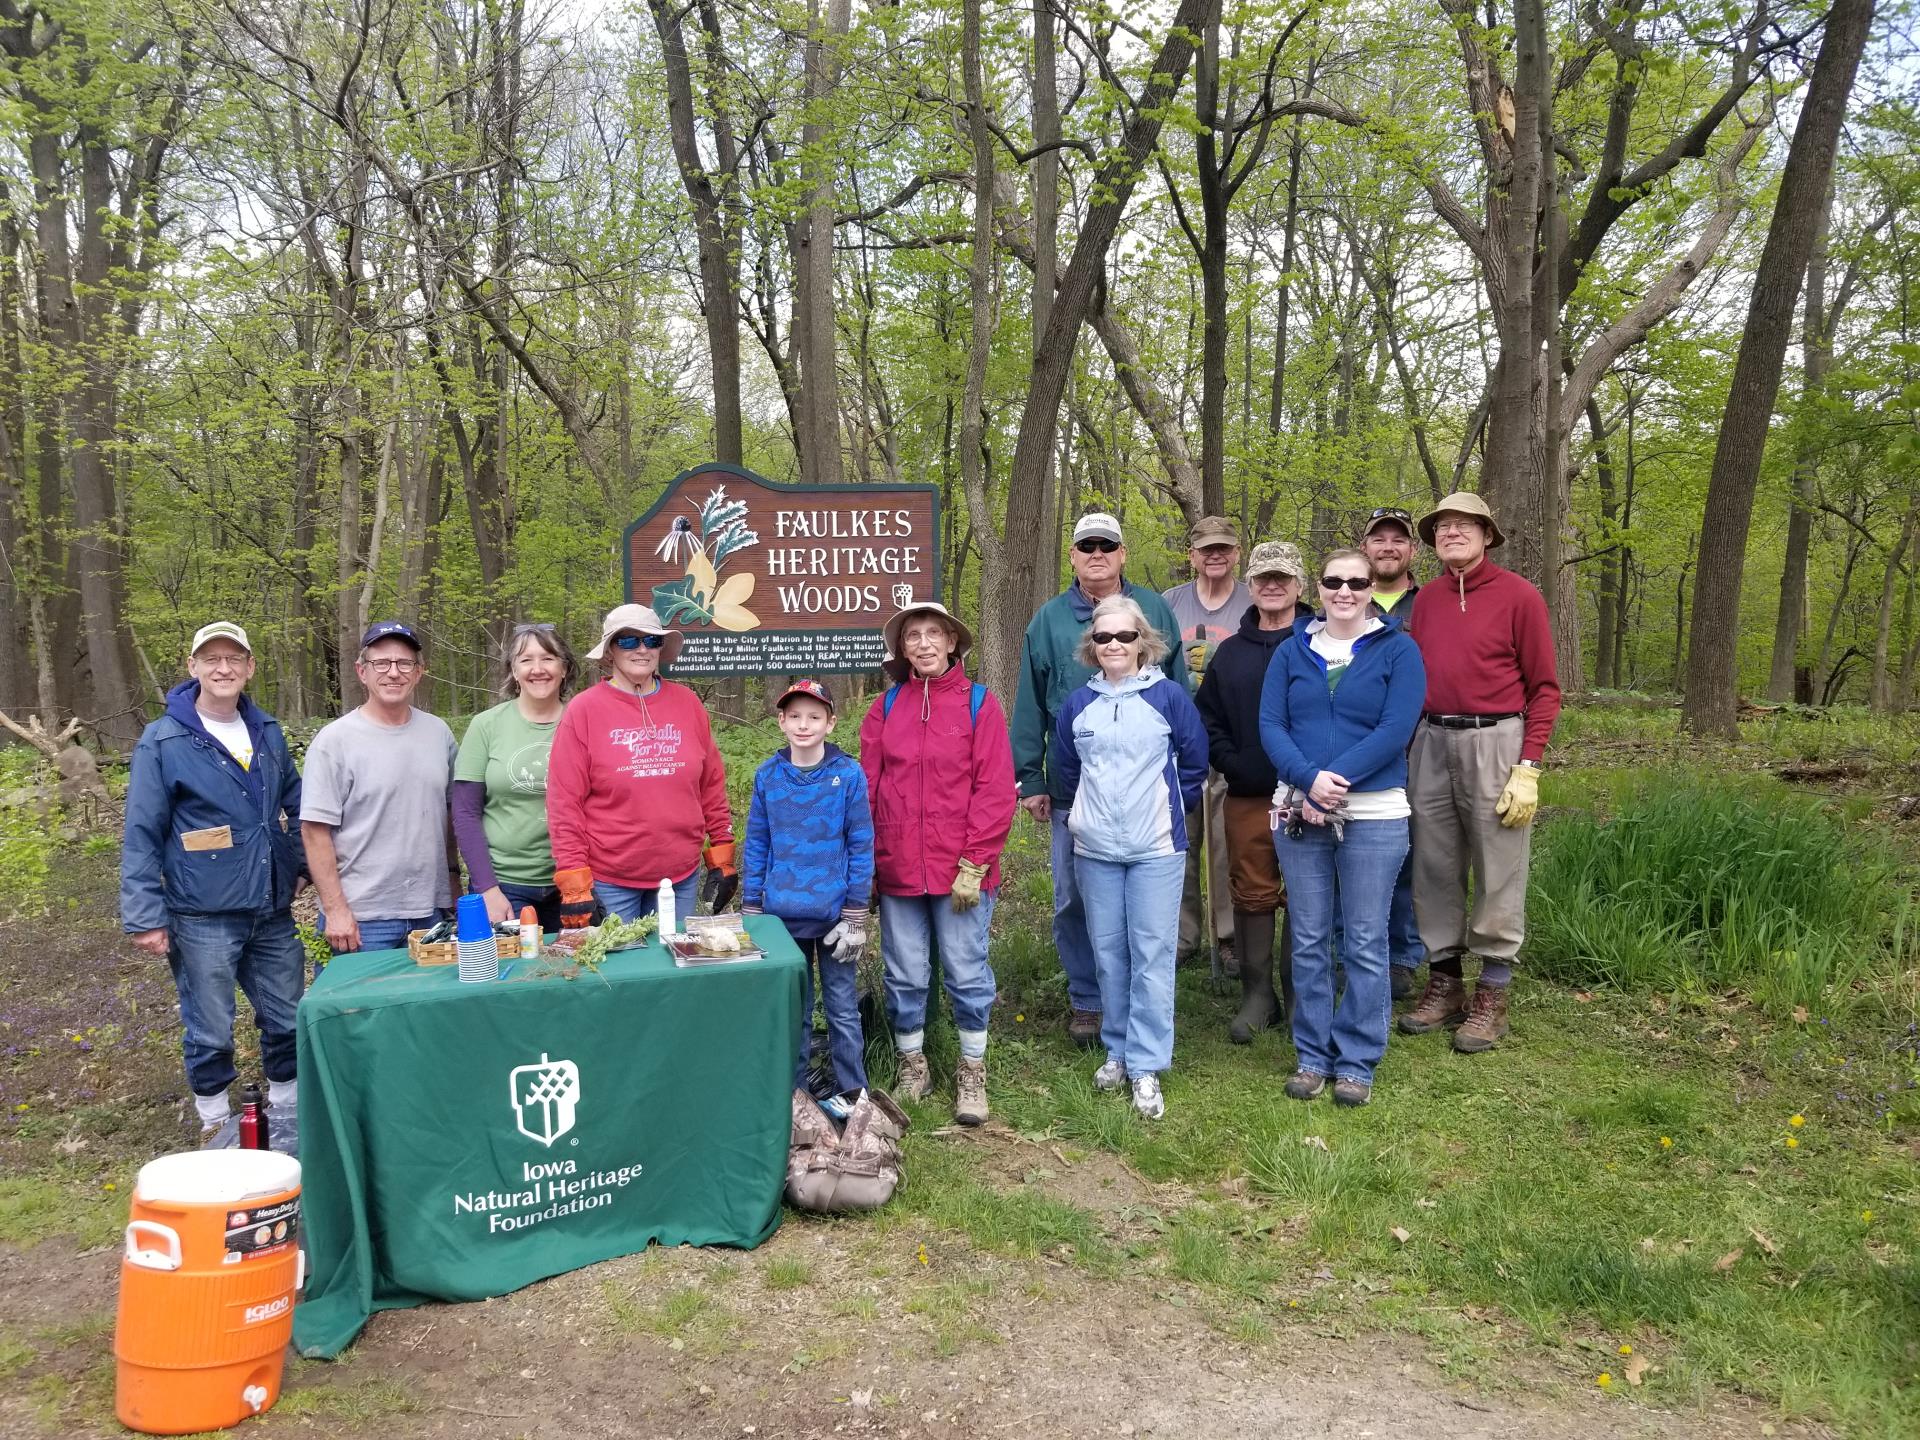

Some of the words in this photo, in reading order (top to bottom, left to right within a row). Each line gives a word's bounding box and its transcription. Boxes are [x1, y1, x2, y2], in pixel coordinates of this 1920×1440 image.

[776, 510, 912, 538] FAULKES
[768, 547, 921, 576] HERITAGE
[778, 580, 880, 612] WOODS
[688, 645, 710, 653] Alice
[713, 645, 733, 654] Mary
[741, 636, 757, 645] City
[804, 635, 812, 643] by
[670, 663, 715, 671] Foundation
[737, 662, 763, 671] nearly
[677, 654, 713, 663] Heritage
[716, 654, 764, 662] Foundation.
[771, 653, 802, 661] Funding
[806, 653, 815, 662] by
[818, 652, 843, 660] REAP,
[846, 651, 885, 659] Hall-Perri
[632, 742, 652, 759] For
[654, 742, 678, 757] You
[524, 1159, 577, 1182] Iowa
[455, 1183, 540, 1214] Natural
[549, 1164, 642, 1200] Heritage
[489, 1192, 612, 1233] Foundation
[246, 1296, 288, 1319] IGLOO
